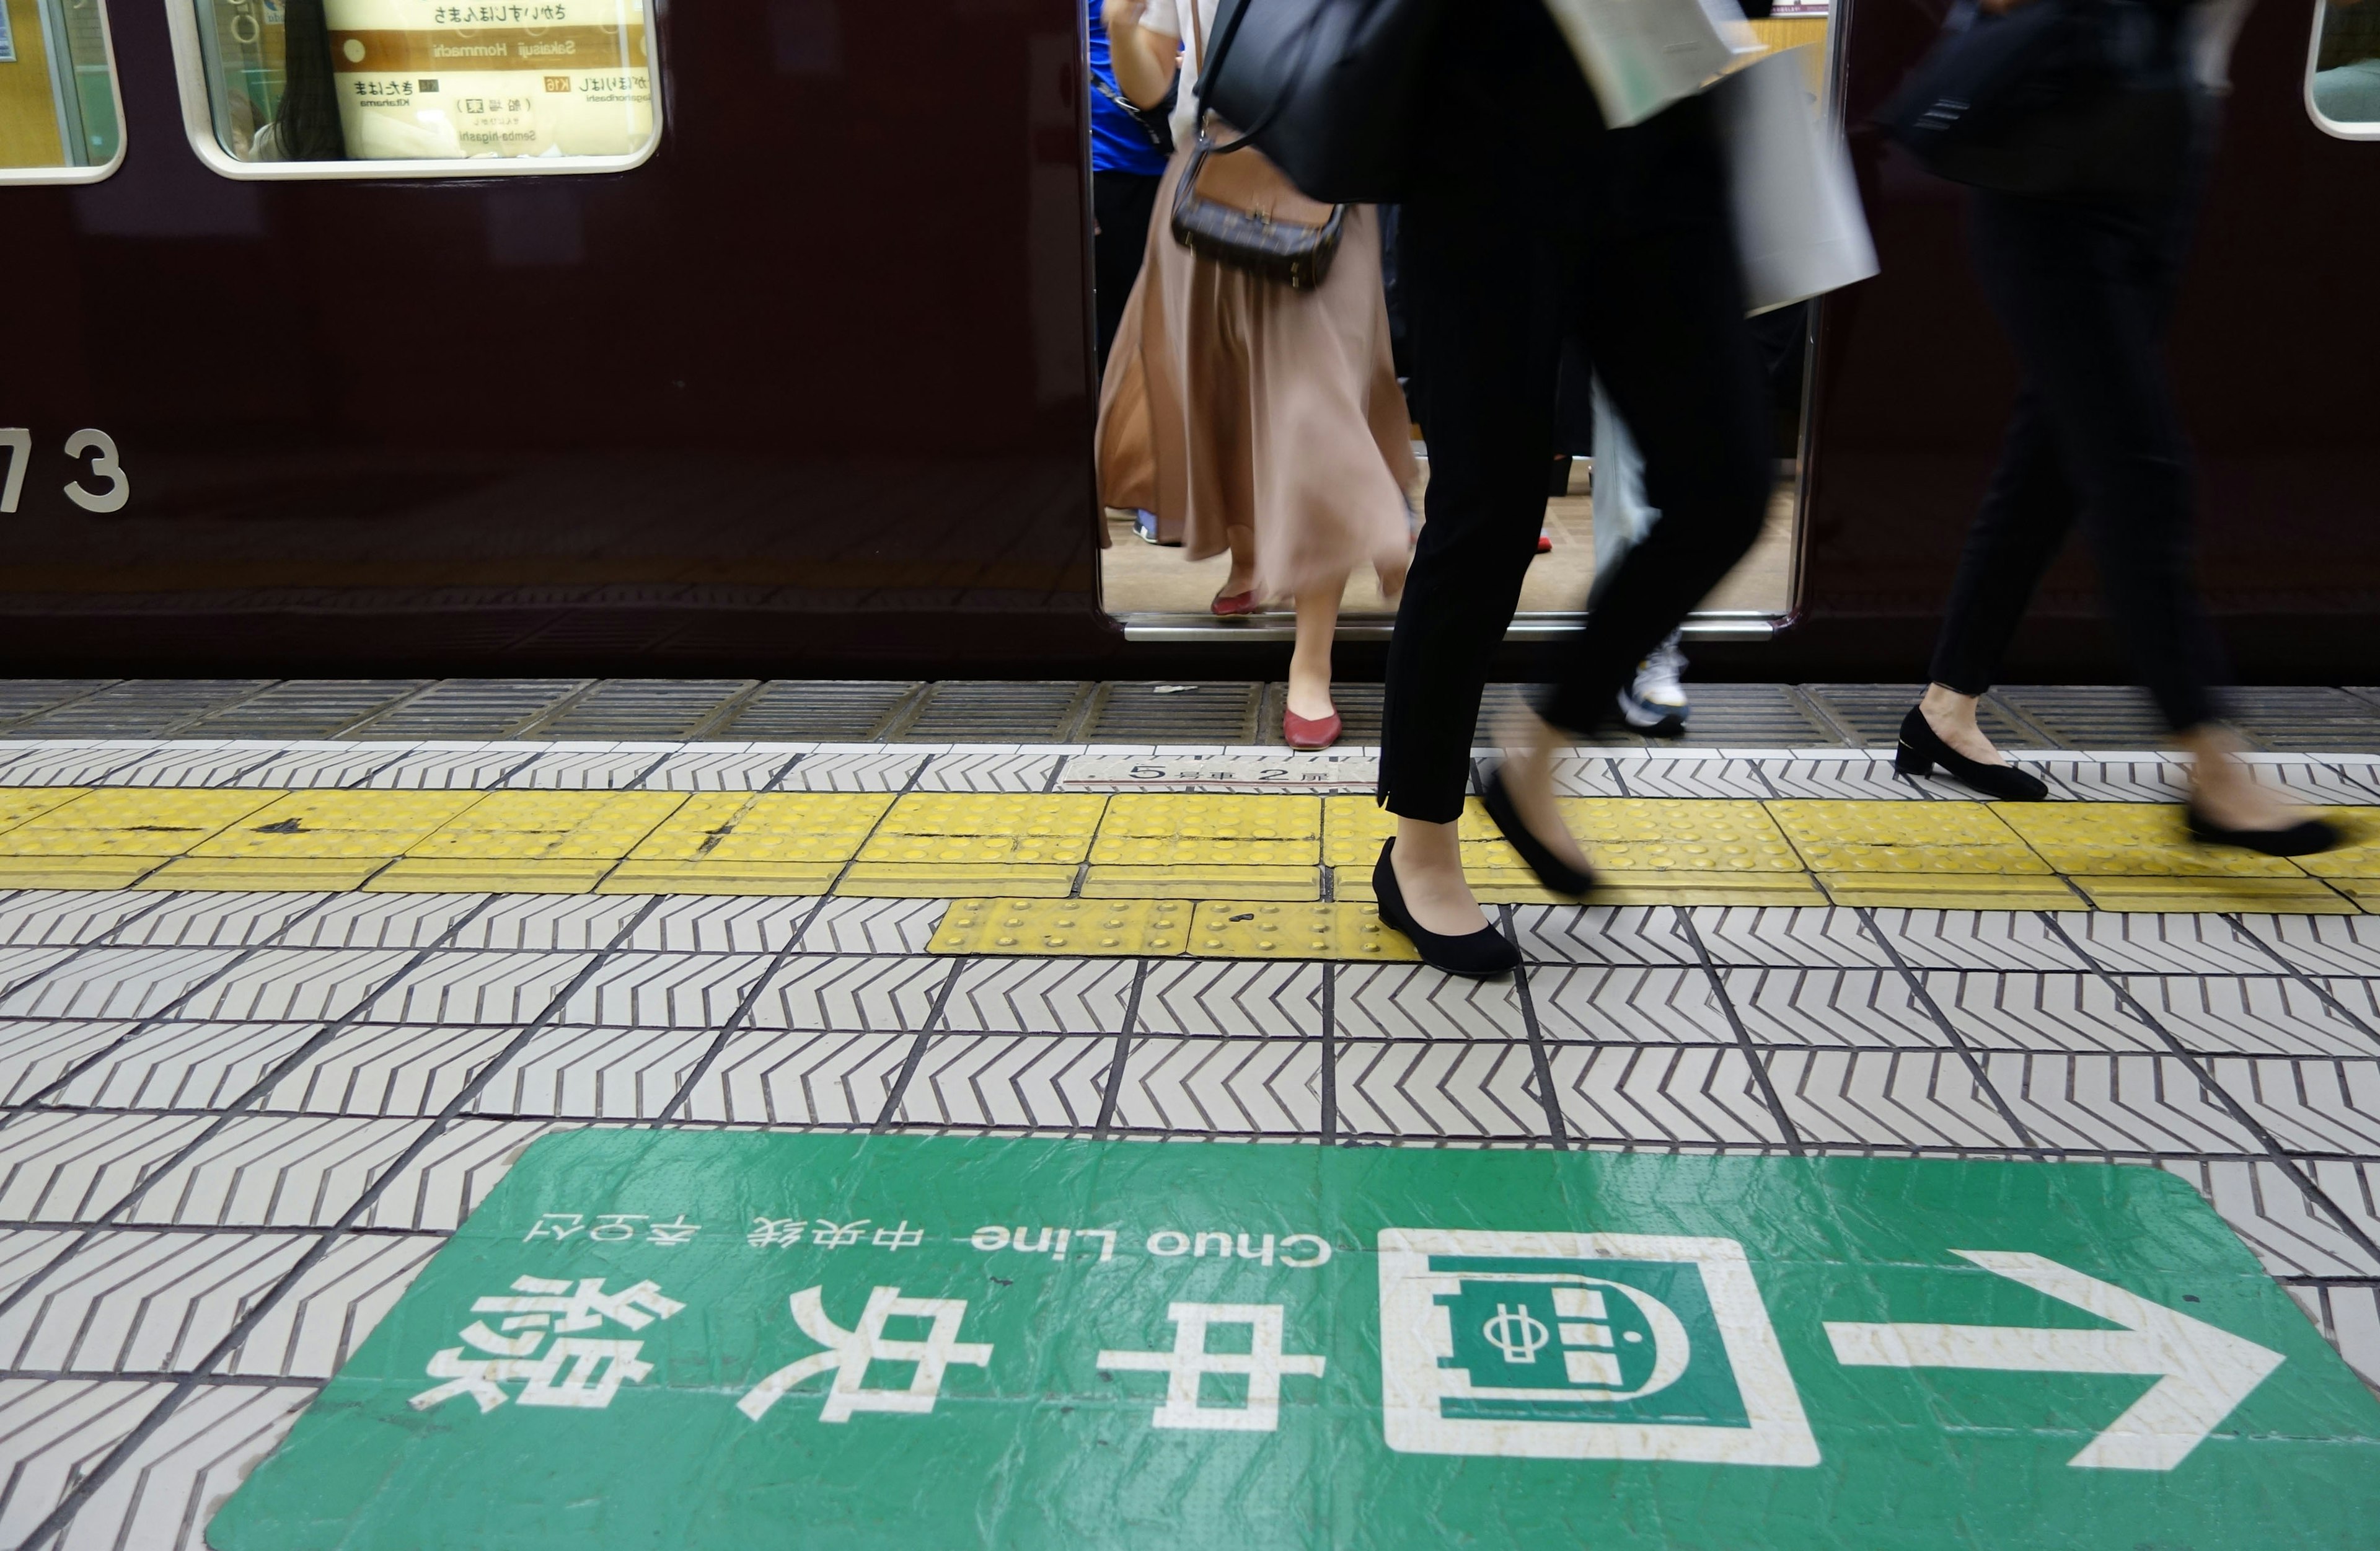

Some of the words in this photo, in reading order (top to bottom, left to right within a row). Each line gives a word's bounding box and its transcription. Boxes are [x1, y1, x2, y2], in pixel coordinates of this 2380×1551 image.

[0, 427, 130, 513] 73
[522, 1213, 702, 1246] 추오선
[746, 1216, 924, 1252] 中央线
[971, 1226, 1118, 1262] Line
[1146, 1230, 1333, 1268] Chuo
